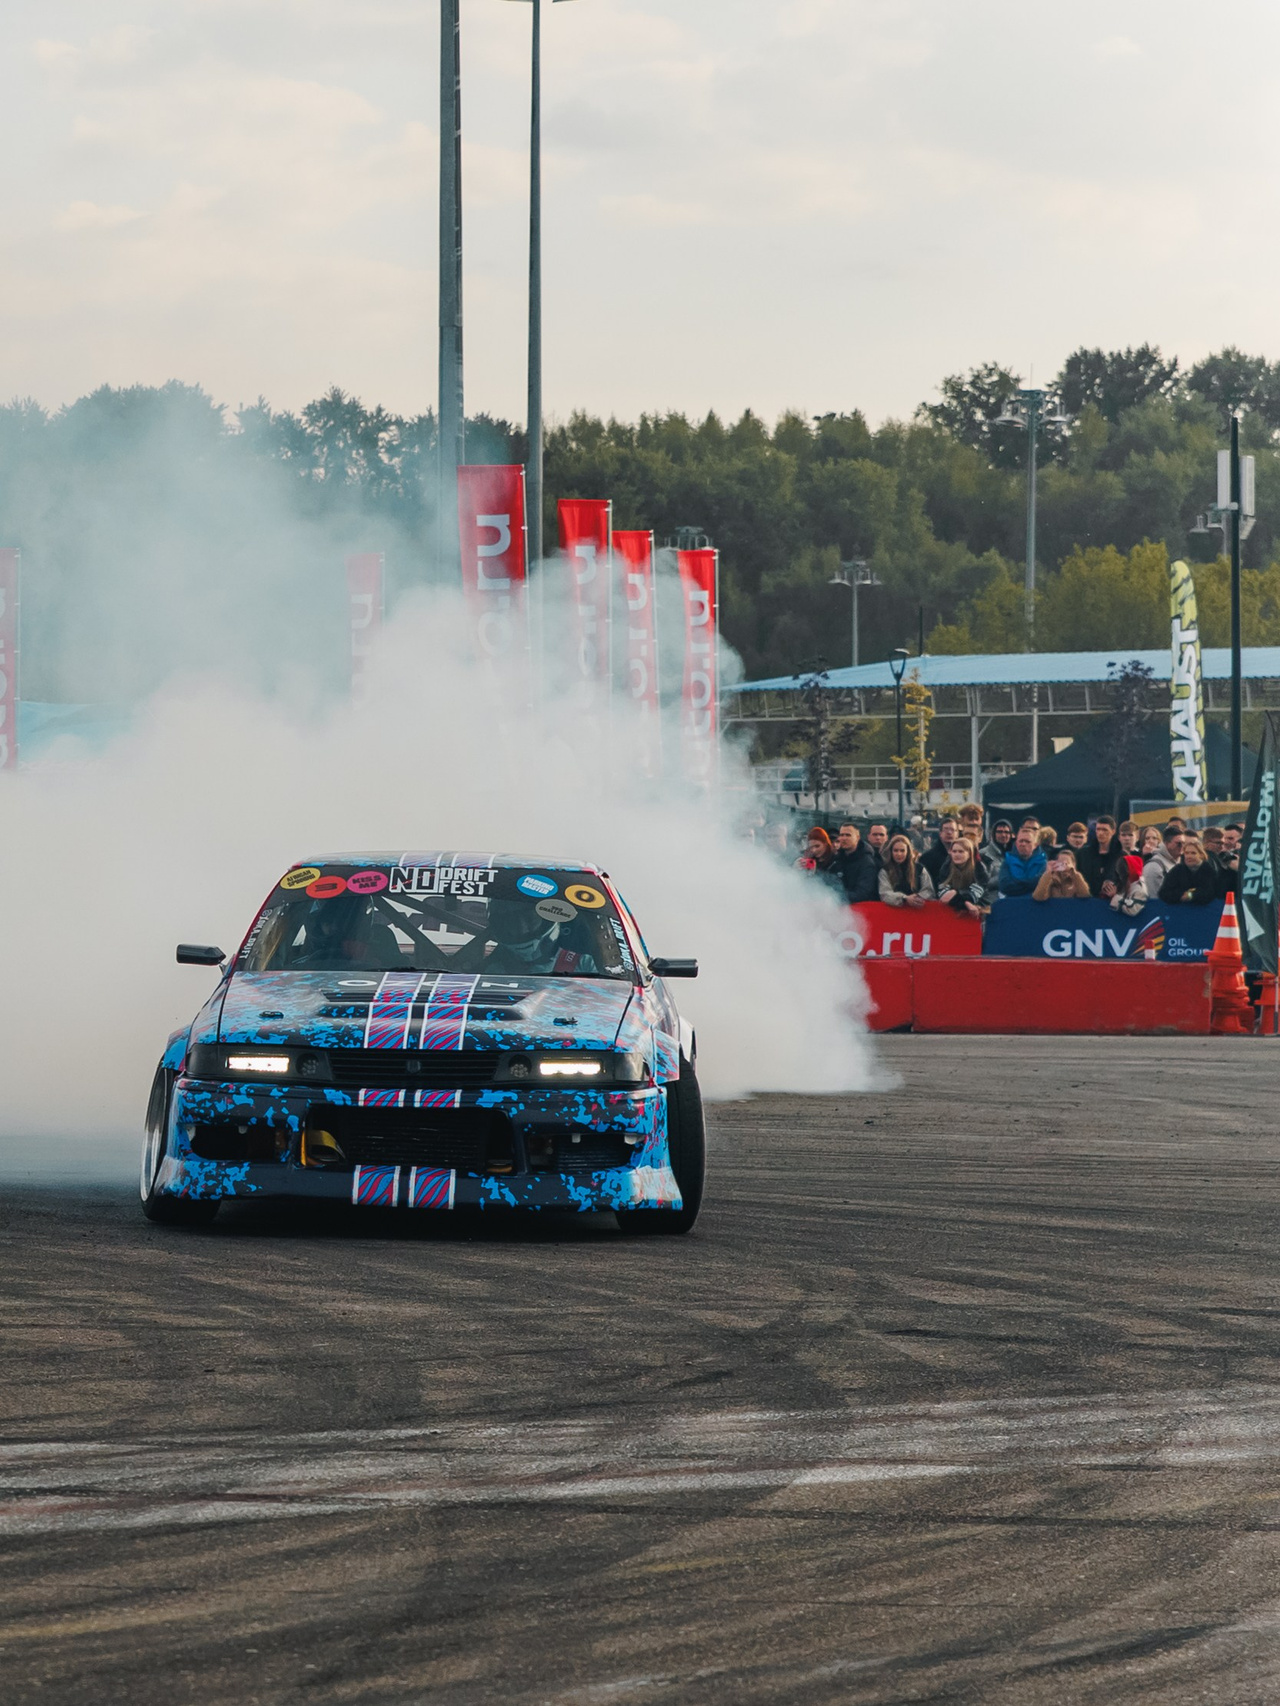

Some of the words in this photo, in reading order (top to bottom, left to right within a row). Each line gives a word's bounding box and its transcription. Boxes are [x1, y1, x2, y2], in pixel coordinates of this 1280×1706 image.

[475, 513, 513, 658] o.ru
[685, 590, 711, 782] uto.ru
[352, 875, 382, 884] KISS
[359, 881, 378, 889] ME
[439, 867, 499, 883] DRIFT
[438, 881, 489, 896] FEST
[834, 931, 932, 959] o.ru
[1042, 928, 1137, 958] GNV
[1167, 937, 1188, 947] OIL
